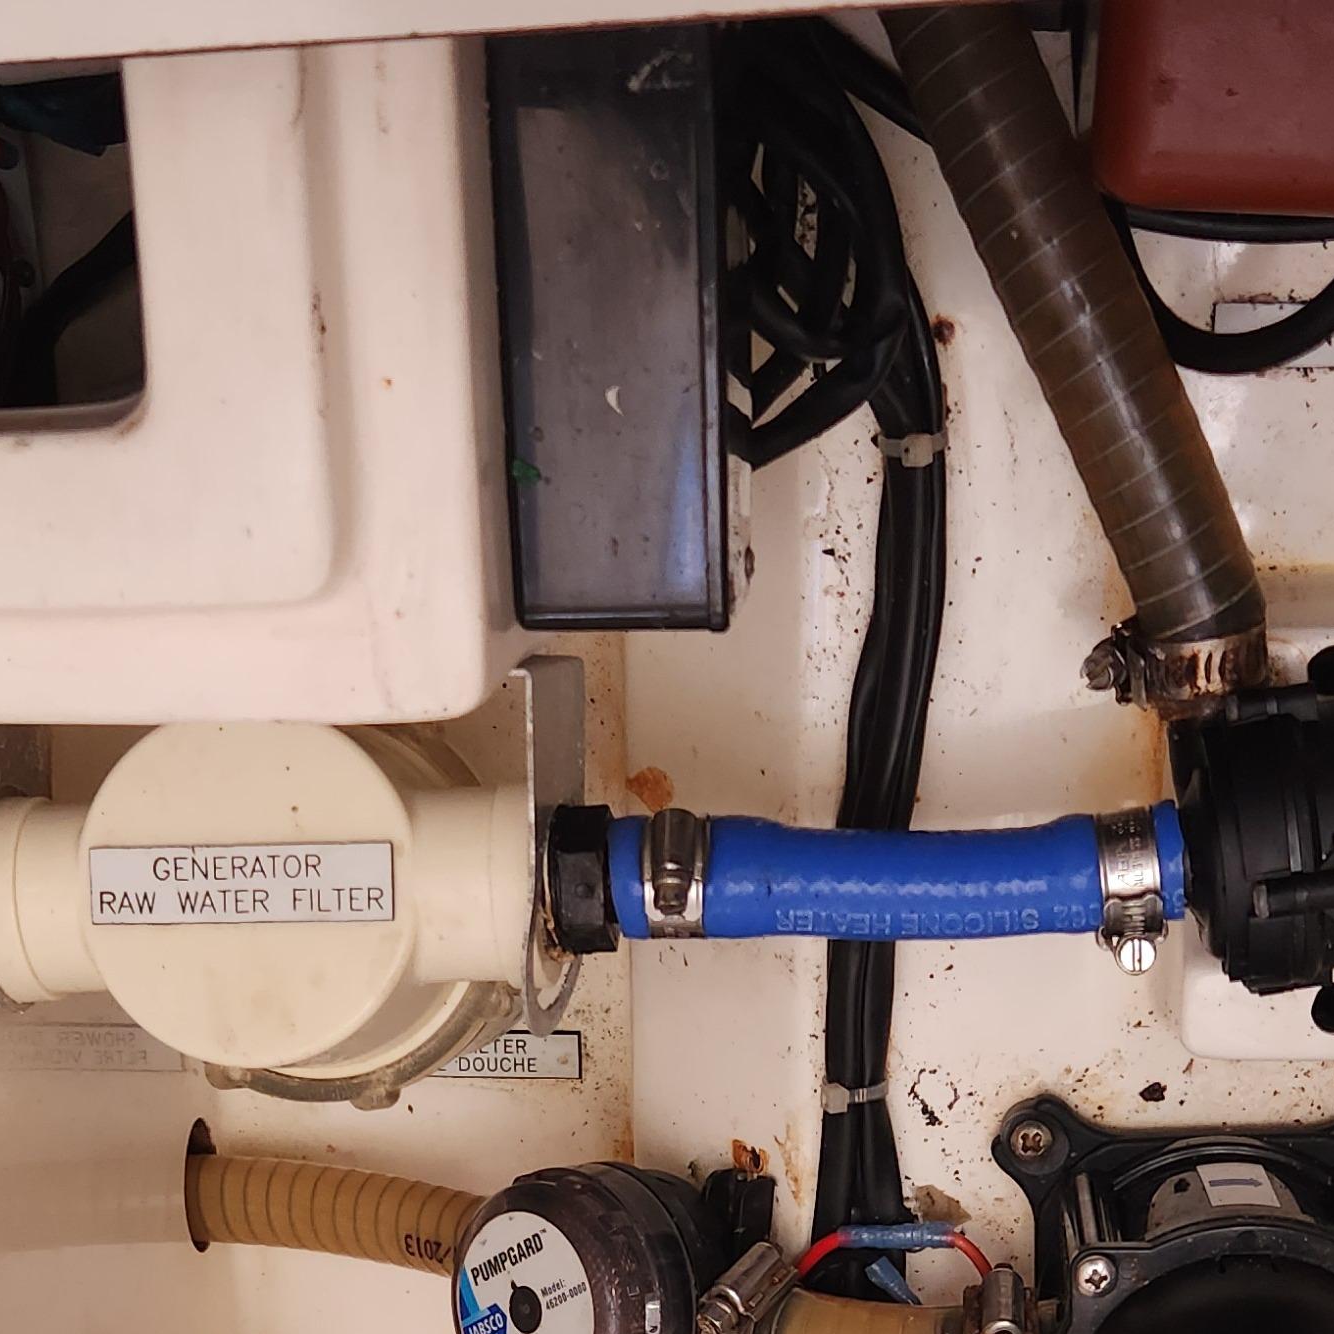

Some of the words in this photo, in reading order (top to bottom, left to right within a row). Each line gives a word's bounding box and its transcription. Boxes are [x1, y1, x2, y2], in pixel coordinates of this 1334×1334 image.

[152, 854, 322, 882] GENERATOR
[100, 891, 155, 914] RAW
[177, 889, 269, 914] WATER
[293, 887, 384, 912] FILTER
[776, 908, 892, 935] HEATER
[901, 906, 1039, 935] SILICONE
[459, 1057, 538, 1073] DOUCHE
[470, 1233, 543, 1286] PUMPGARD
